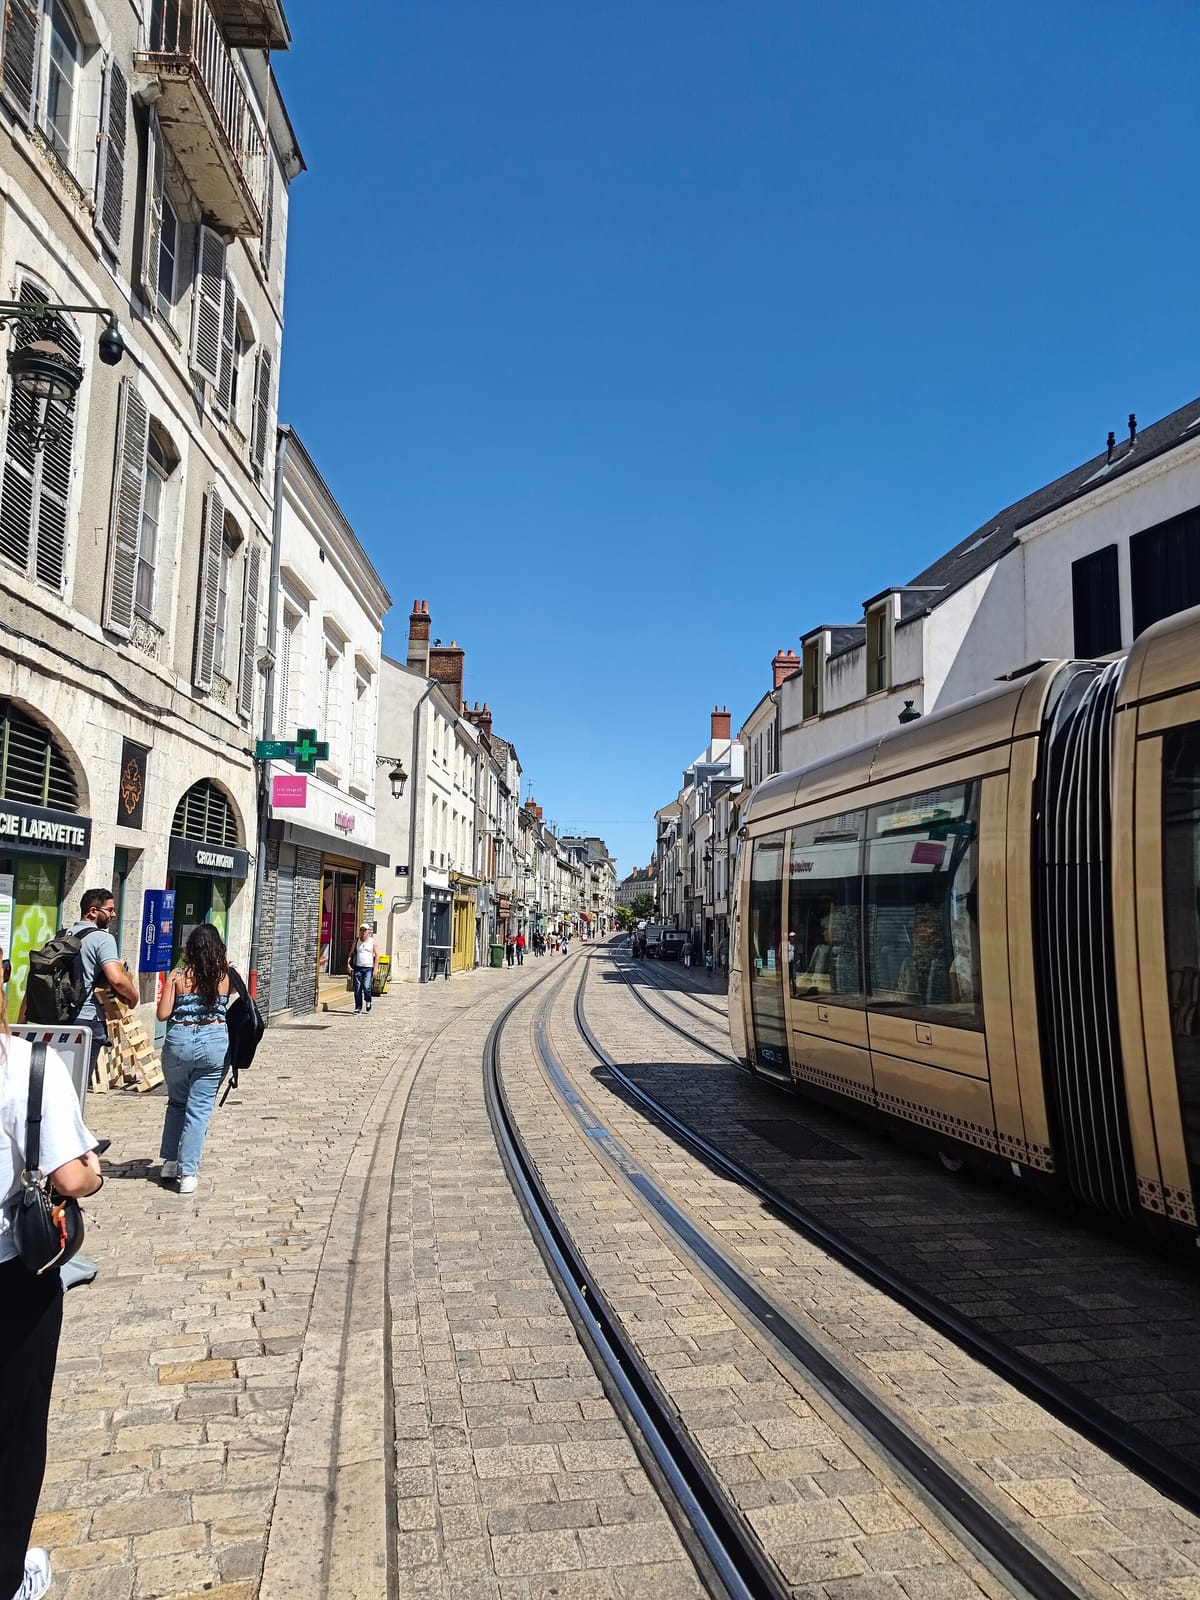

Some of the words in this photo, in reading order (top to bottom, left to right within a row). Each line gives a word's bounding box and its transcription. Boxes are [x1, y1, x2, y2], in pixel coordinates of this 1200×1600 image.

[20, 817, 86, 847] LAFAYETTE
[196, 850, 216, 867] CROIX
[215, 853, 235, 869] MORIN
